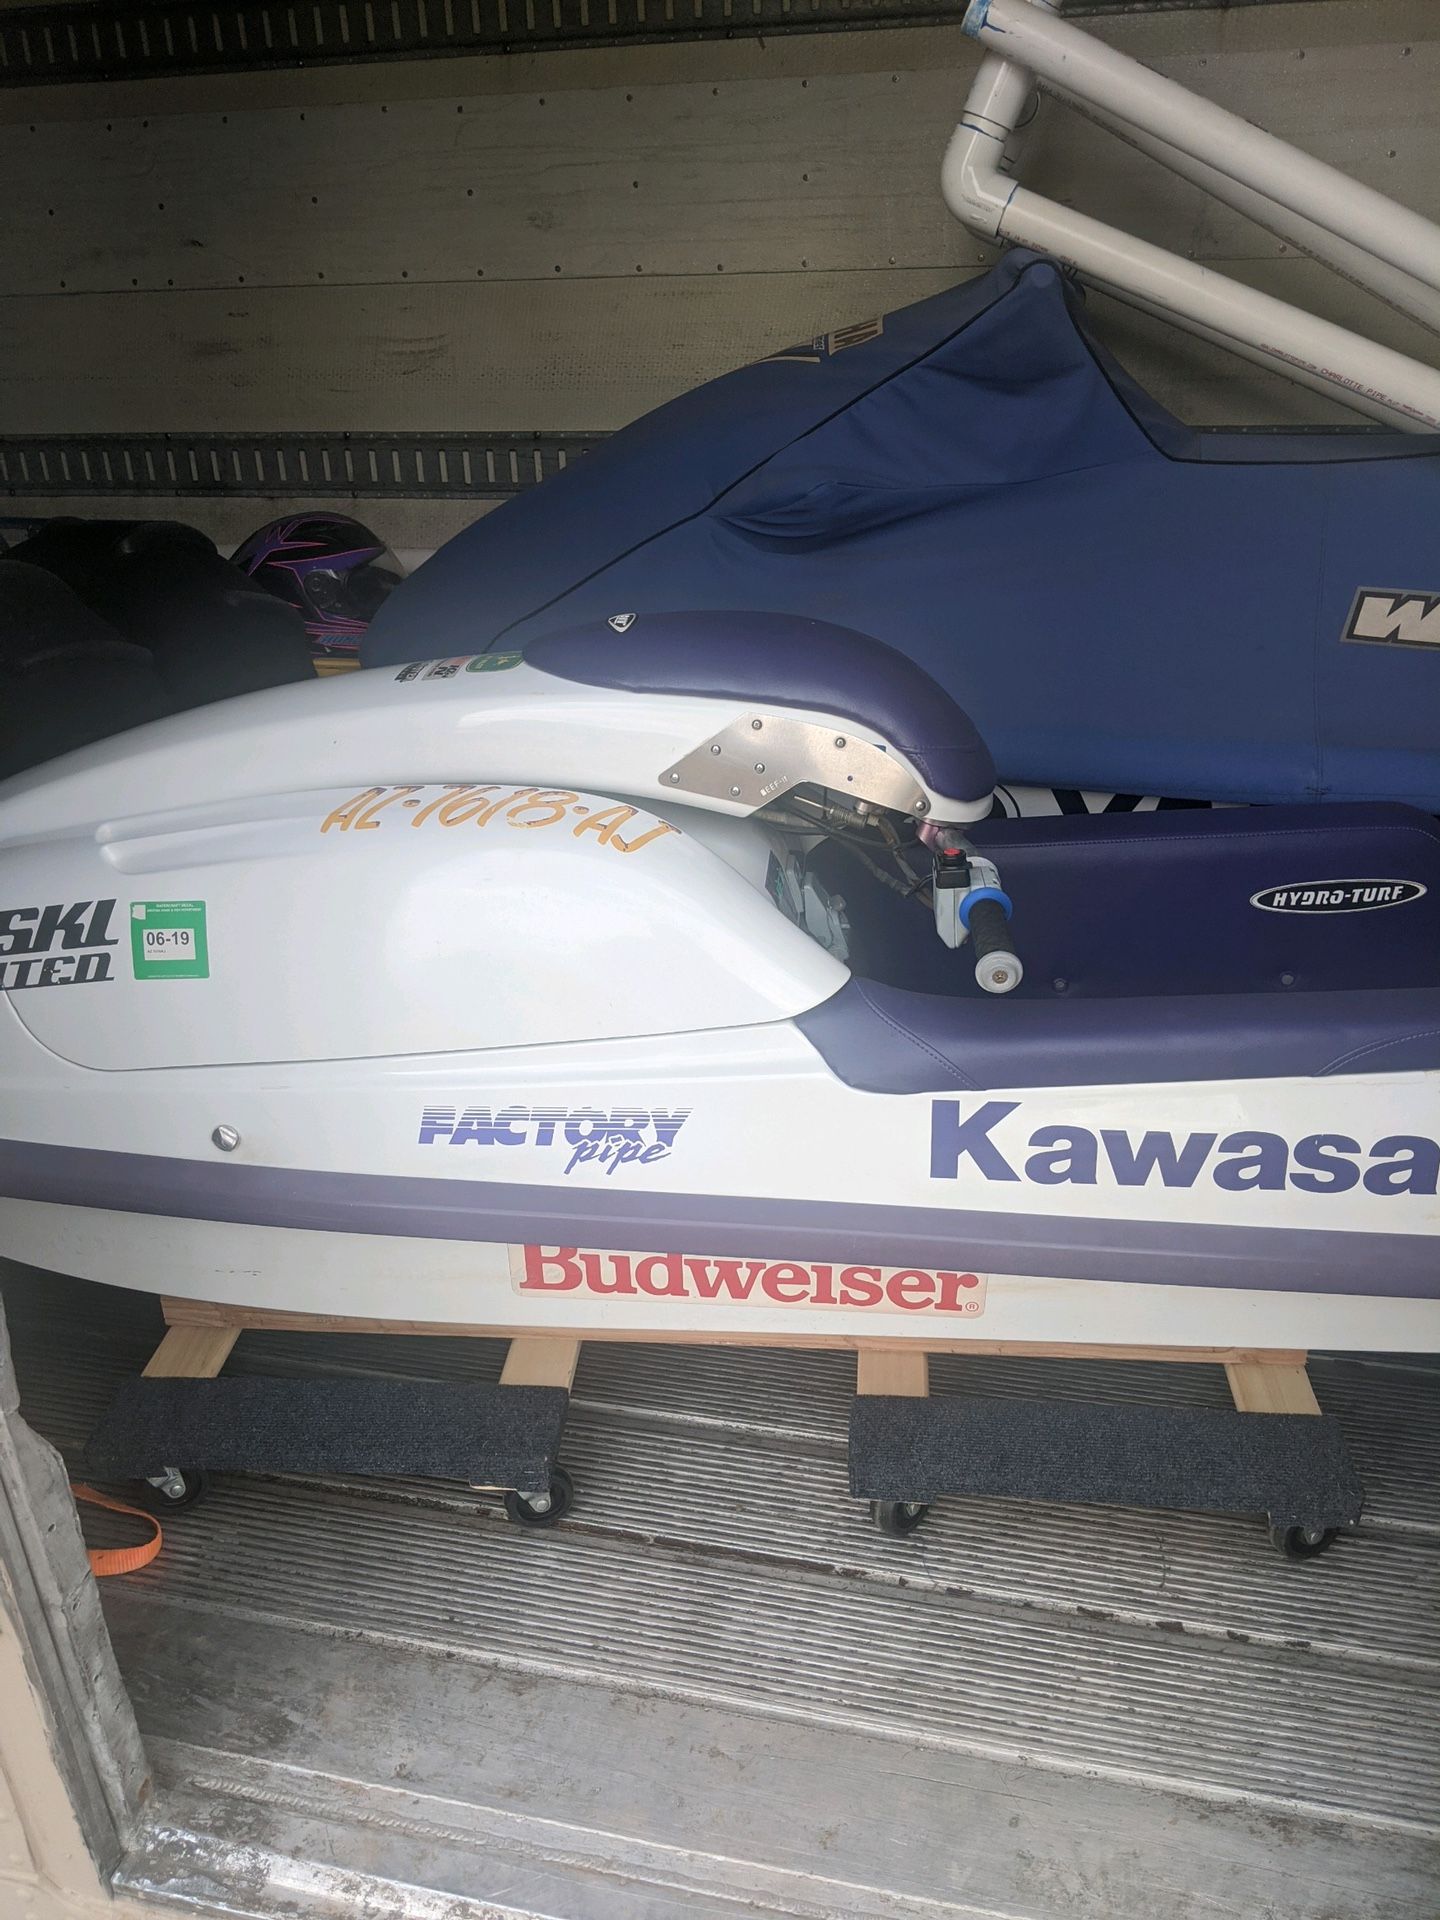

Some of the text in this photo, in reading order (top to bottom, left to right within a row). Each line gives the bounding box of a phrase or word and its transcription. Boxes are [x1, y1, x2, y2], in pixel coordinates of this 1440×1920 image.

[1320, 367, 1363, 391] CHARLOTTE
[1366, 387, 1387, 401] PIPE
[1272, 885, 1404, 907] HYDRO-TURF
[146, 931, 190, 946] 06-19
[418, 1105, 693, 1147] FACTORY
[563, 1135, 672, 1175] pipe
[930, 1099, 1440, 1195] Kawasa
[519, 1244, 980, 1311] Budweiser
